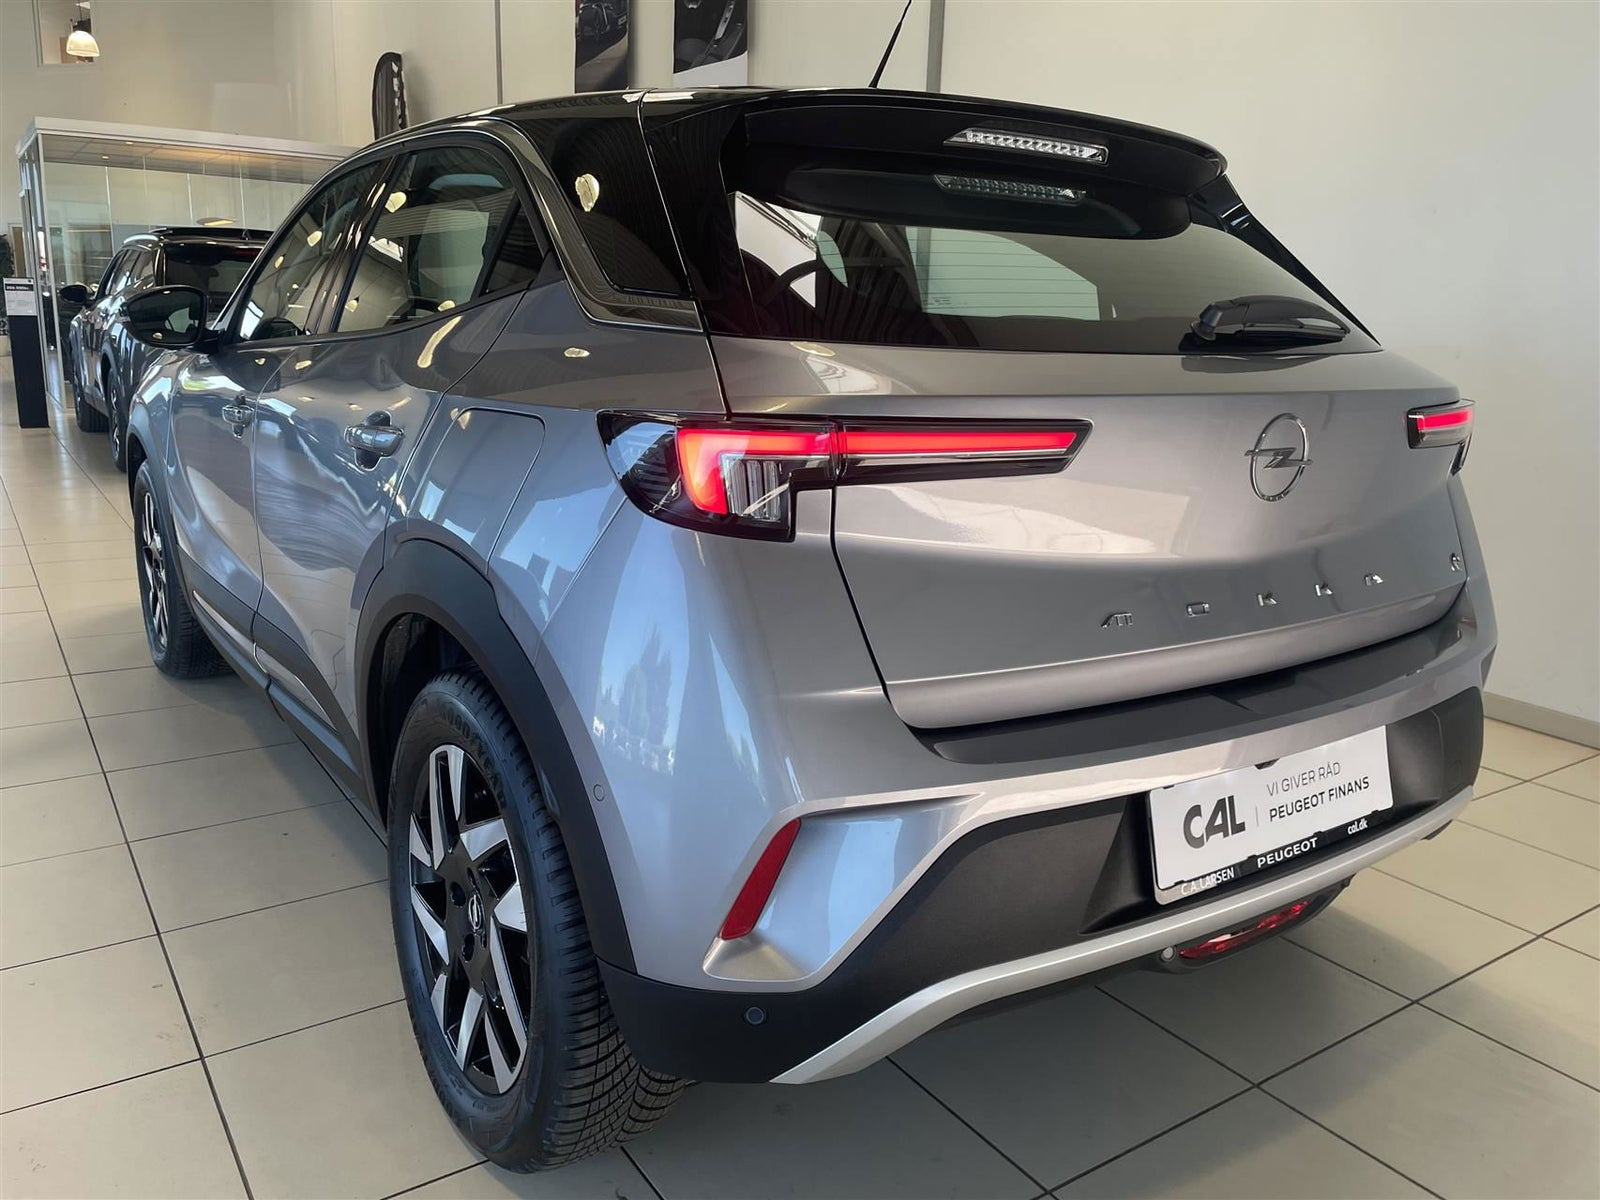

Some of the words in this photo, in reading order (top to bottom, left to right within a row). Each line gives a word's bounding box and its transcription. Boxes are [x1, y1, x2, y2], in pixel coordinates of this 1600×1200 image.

[1266, 781, 1279, 797] VI
[1281, 769, 1316, 793] GIVER
[1318, 761, 1341, 780] RÅD
[1269, 791, 1326, 822] PEUGEOT
[1328, 776, 1370, 802] FINANS
[1183, 794, 1246, 849] CAL
[1257, 837, 1319, 869] PEUGEOT
[1200, 866, 1234, 888] LARSEN
